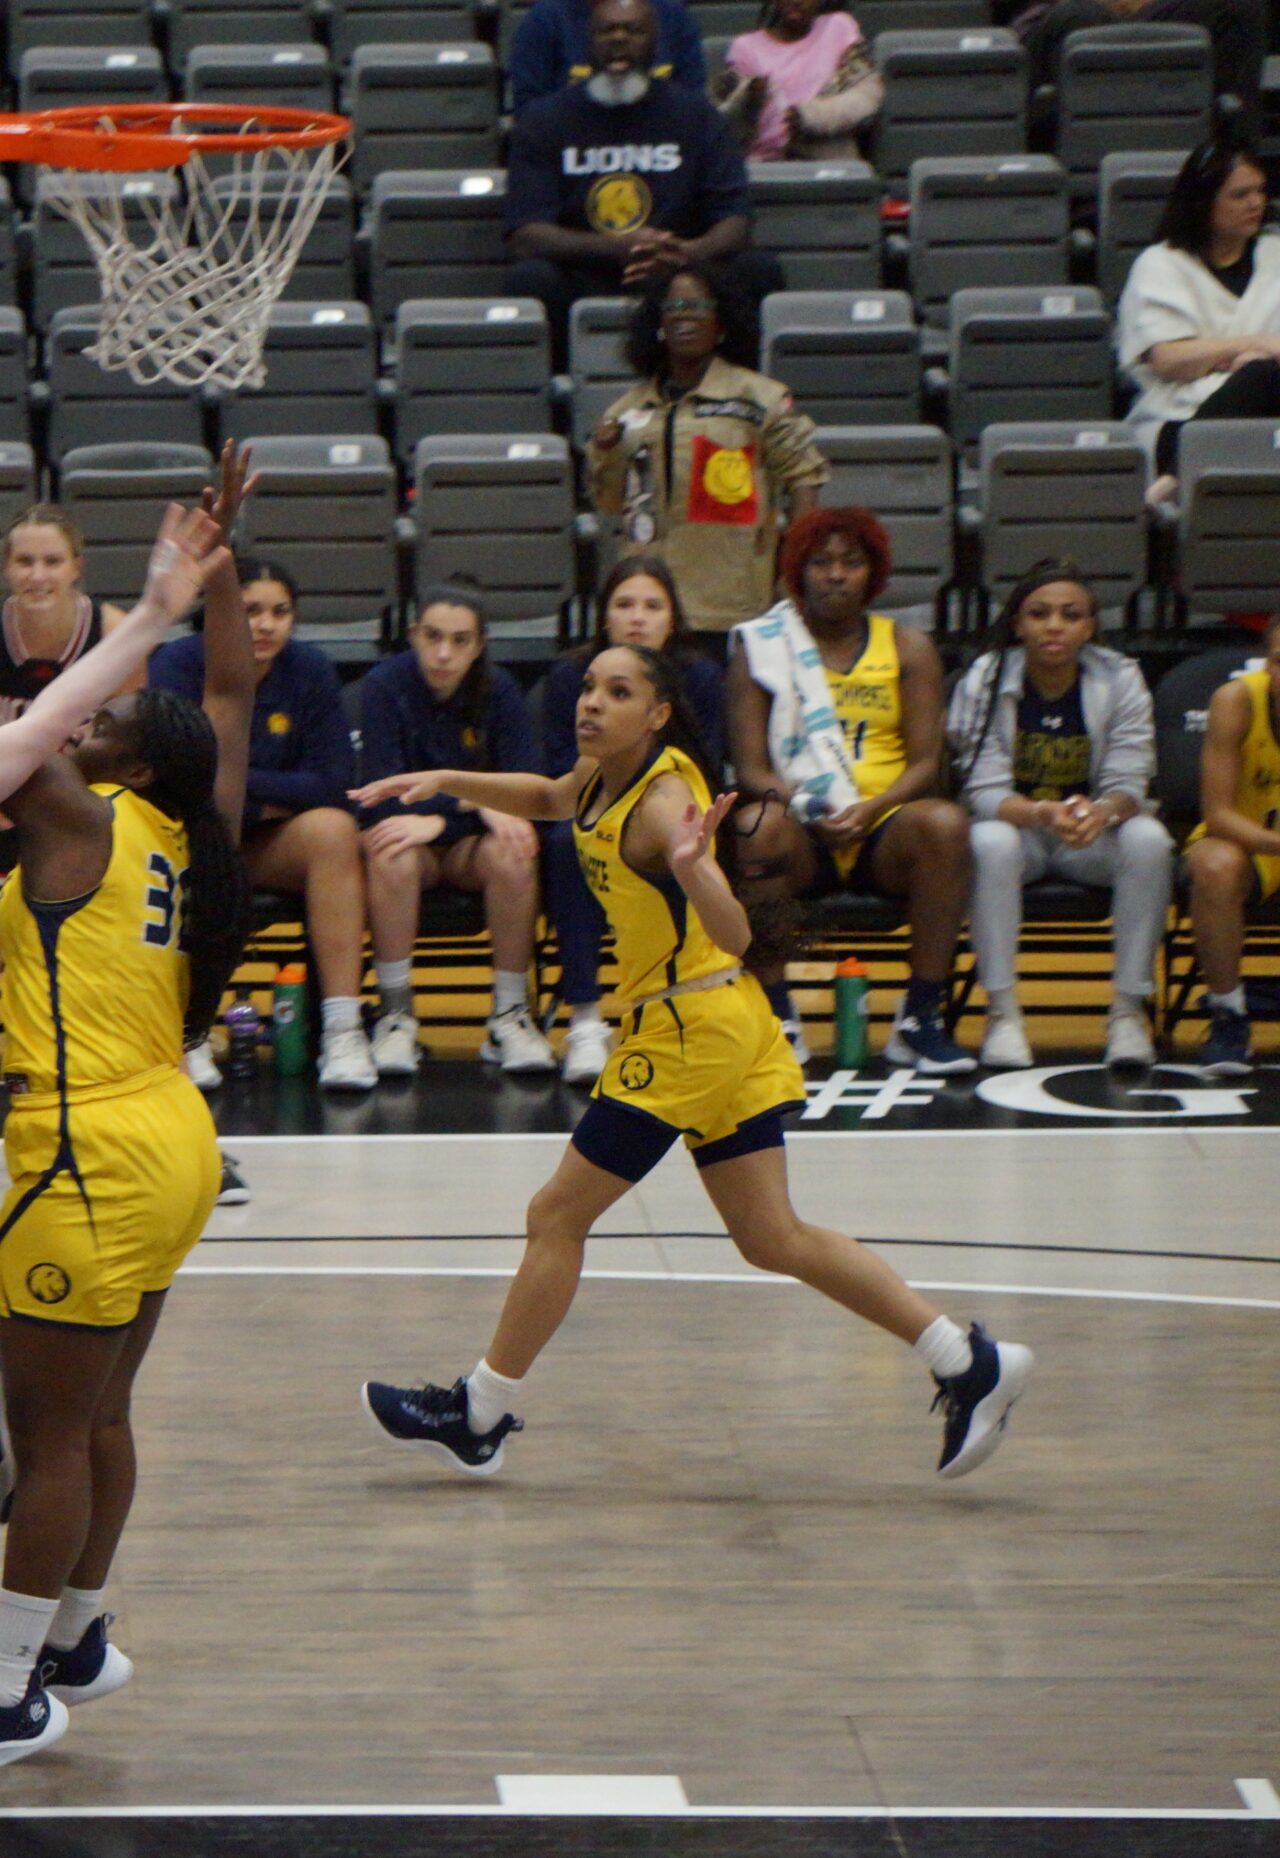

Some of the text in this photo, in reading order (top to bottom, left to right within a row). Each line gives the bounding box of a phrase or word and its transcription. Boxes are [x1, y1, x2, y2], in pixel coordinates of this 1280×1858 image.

[562, 143, 682, 176] LIONS
[141, 851, 190, 956] 3
[800, 1062, 1280, 1120] #G
